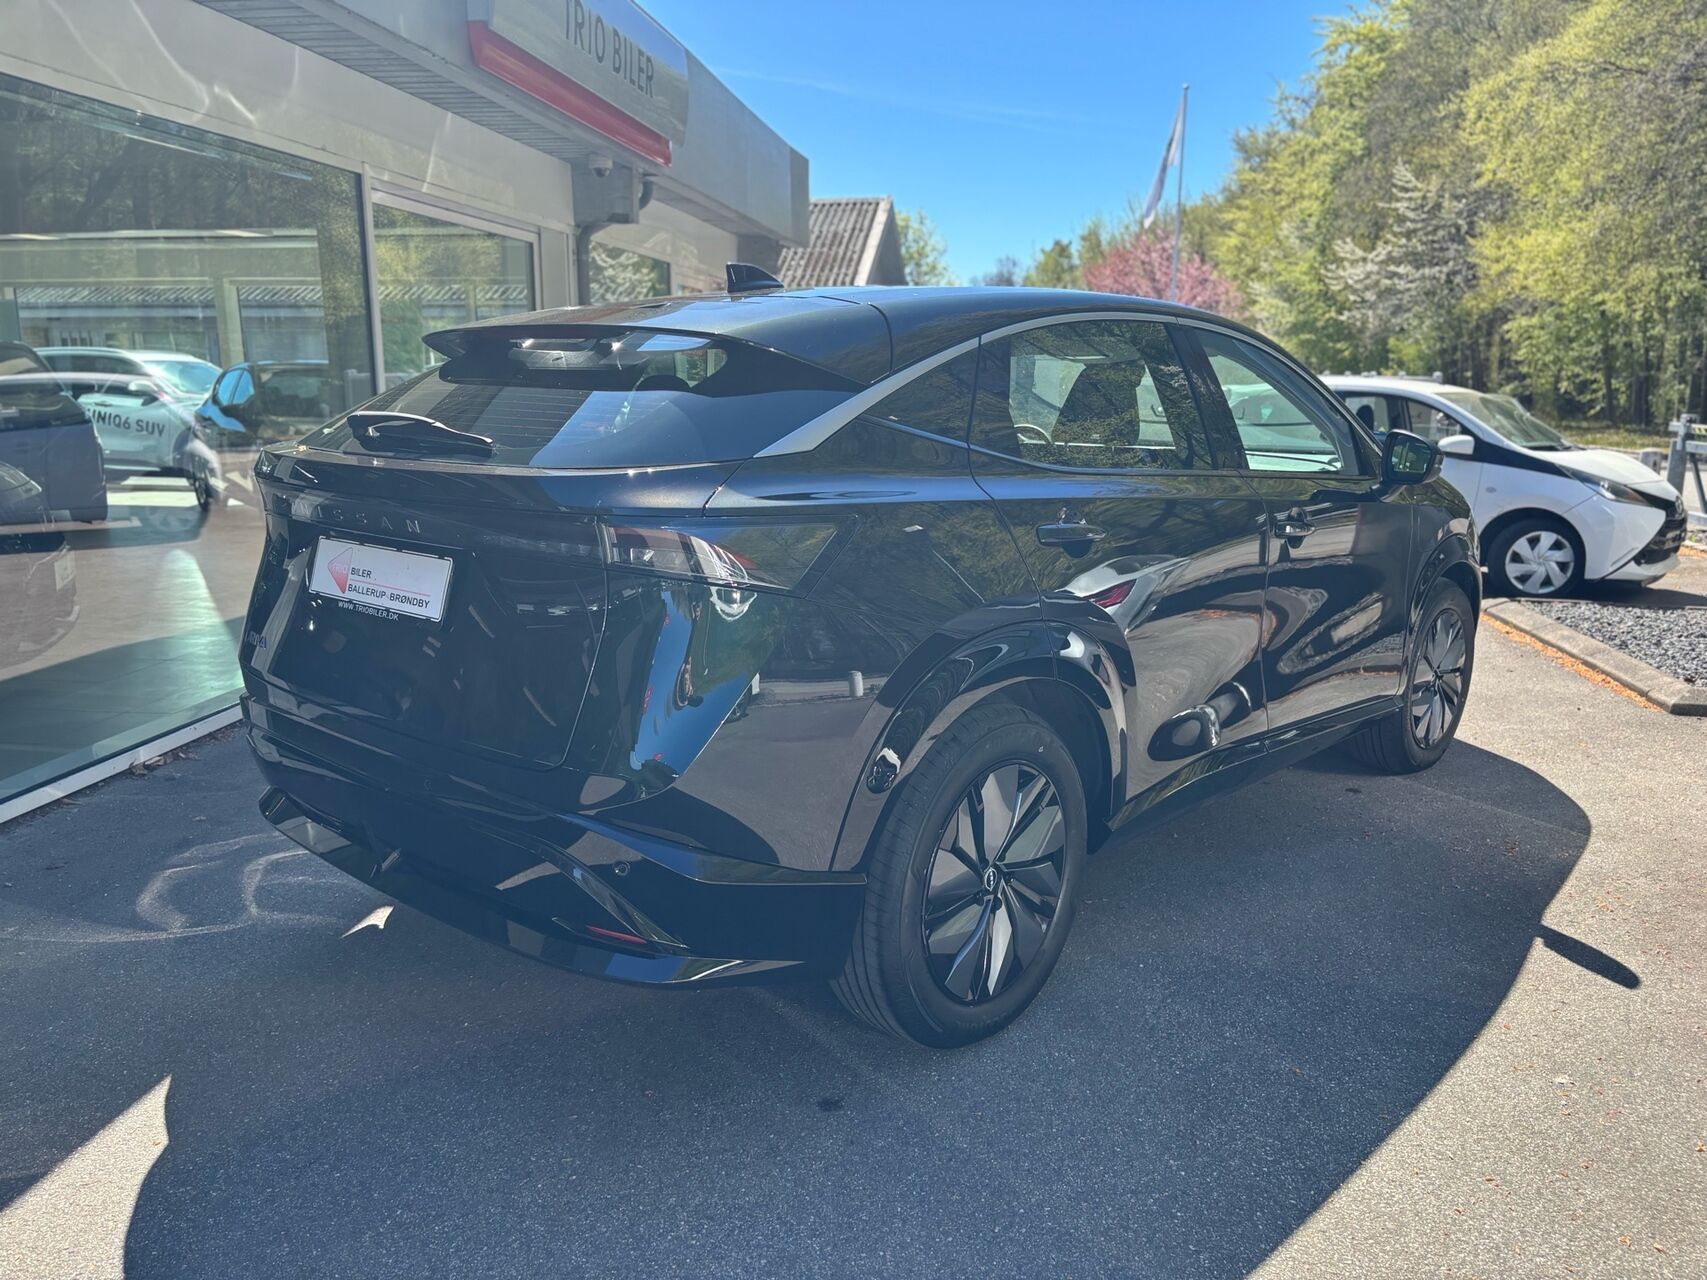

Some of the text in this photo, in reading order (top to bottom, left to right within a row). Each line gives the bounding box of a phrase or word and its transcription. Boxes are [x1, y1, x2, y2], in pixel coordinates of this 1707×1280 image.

[612, 25, 654, 98] BILER
[135, 419, 165, 437] SUV
[350, 567, 372, 580] BILER
[338, 600, 399, 621] WWW.TRIOBILER.DK
